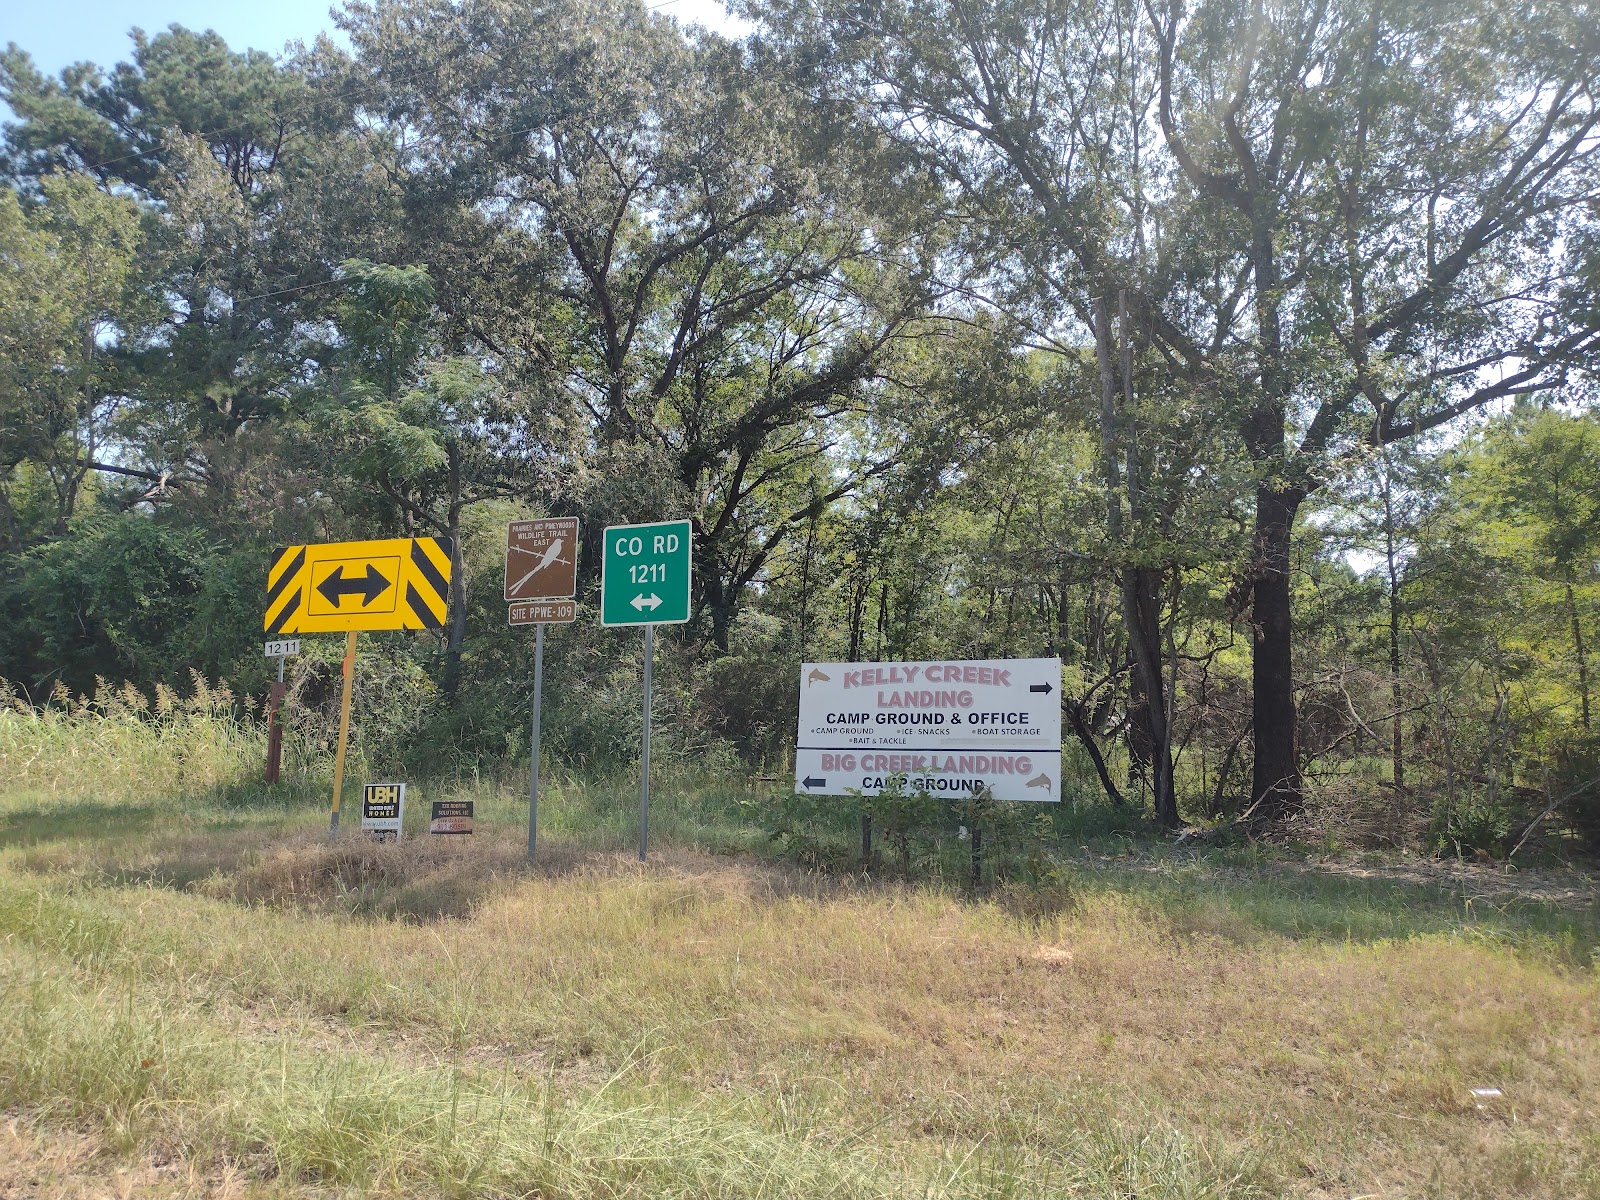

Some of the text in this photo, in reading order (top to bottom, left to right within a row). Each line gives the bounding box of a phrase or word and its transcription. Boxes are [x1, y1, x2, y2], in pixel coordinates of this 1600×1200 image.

[512, 521, 575, 533] PRAIRIES AND PINEYWOODS
[517, 530, 568, 540] WILDLIFE TRAIL
[533, 539, 550, 547] EAST
[615, 534, 679, 557] CO RD
[629, 563, 666, 584] 1211
[512, 606, 572, 620] SITE PPWE-109
[843, 665, 1012, 690] KELLY CREEK
[877, 690, 974, 709] LANDING
[826, 712, 1029, 725] CAMP GROUND & OFFICE
[815, 727, 838, 735] CAMP
[839, 727, 874, 735] GROUND
[918, 728, 950, 736] SNACKS
[821, 753, 1033, 775] BIG CREEK LANDING
[914, 778, 985, 791] GROUND
[367, 786, 398, 804] UBH
